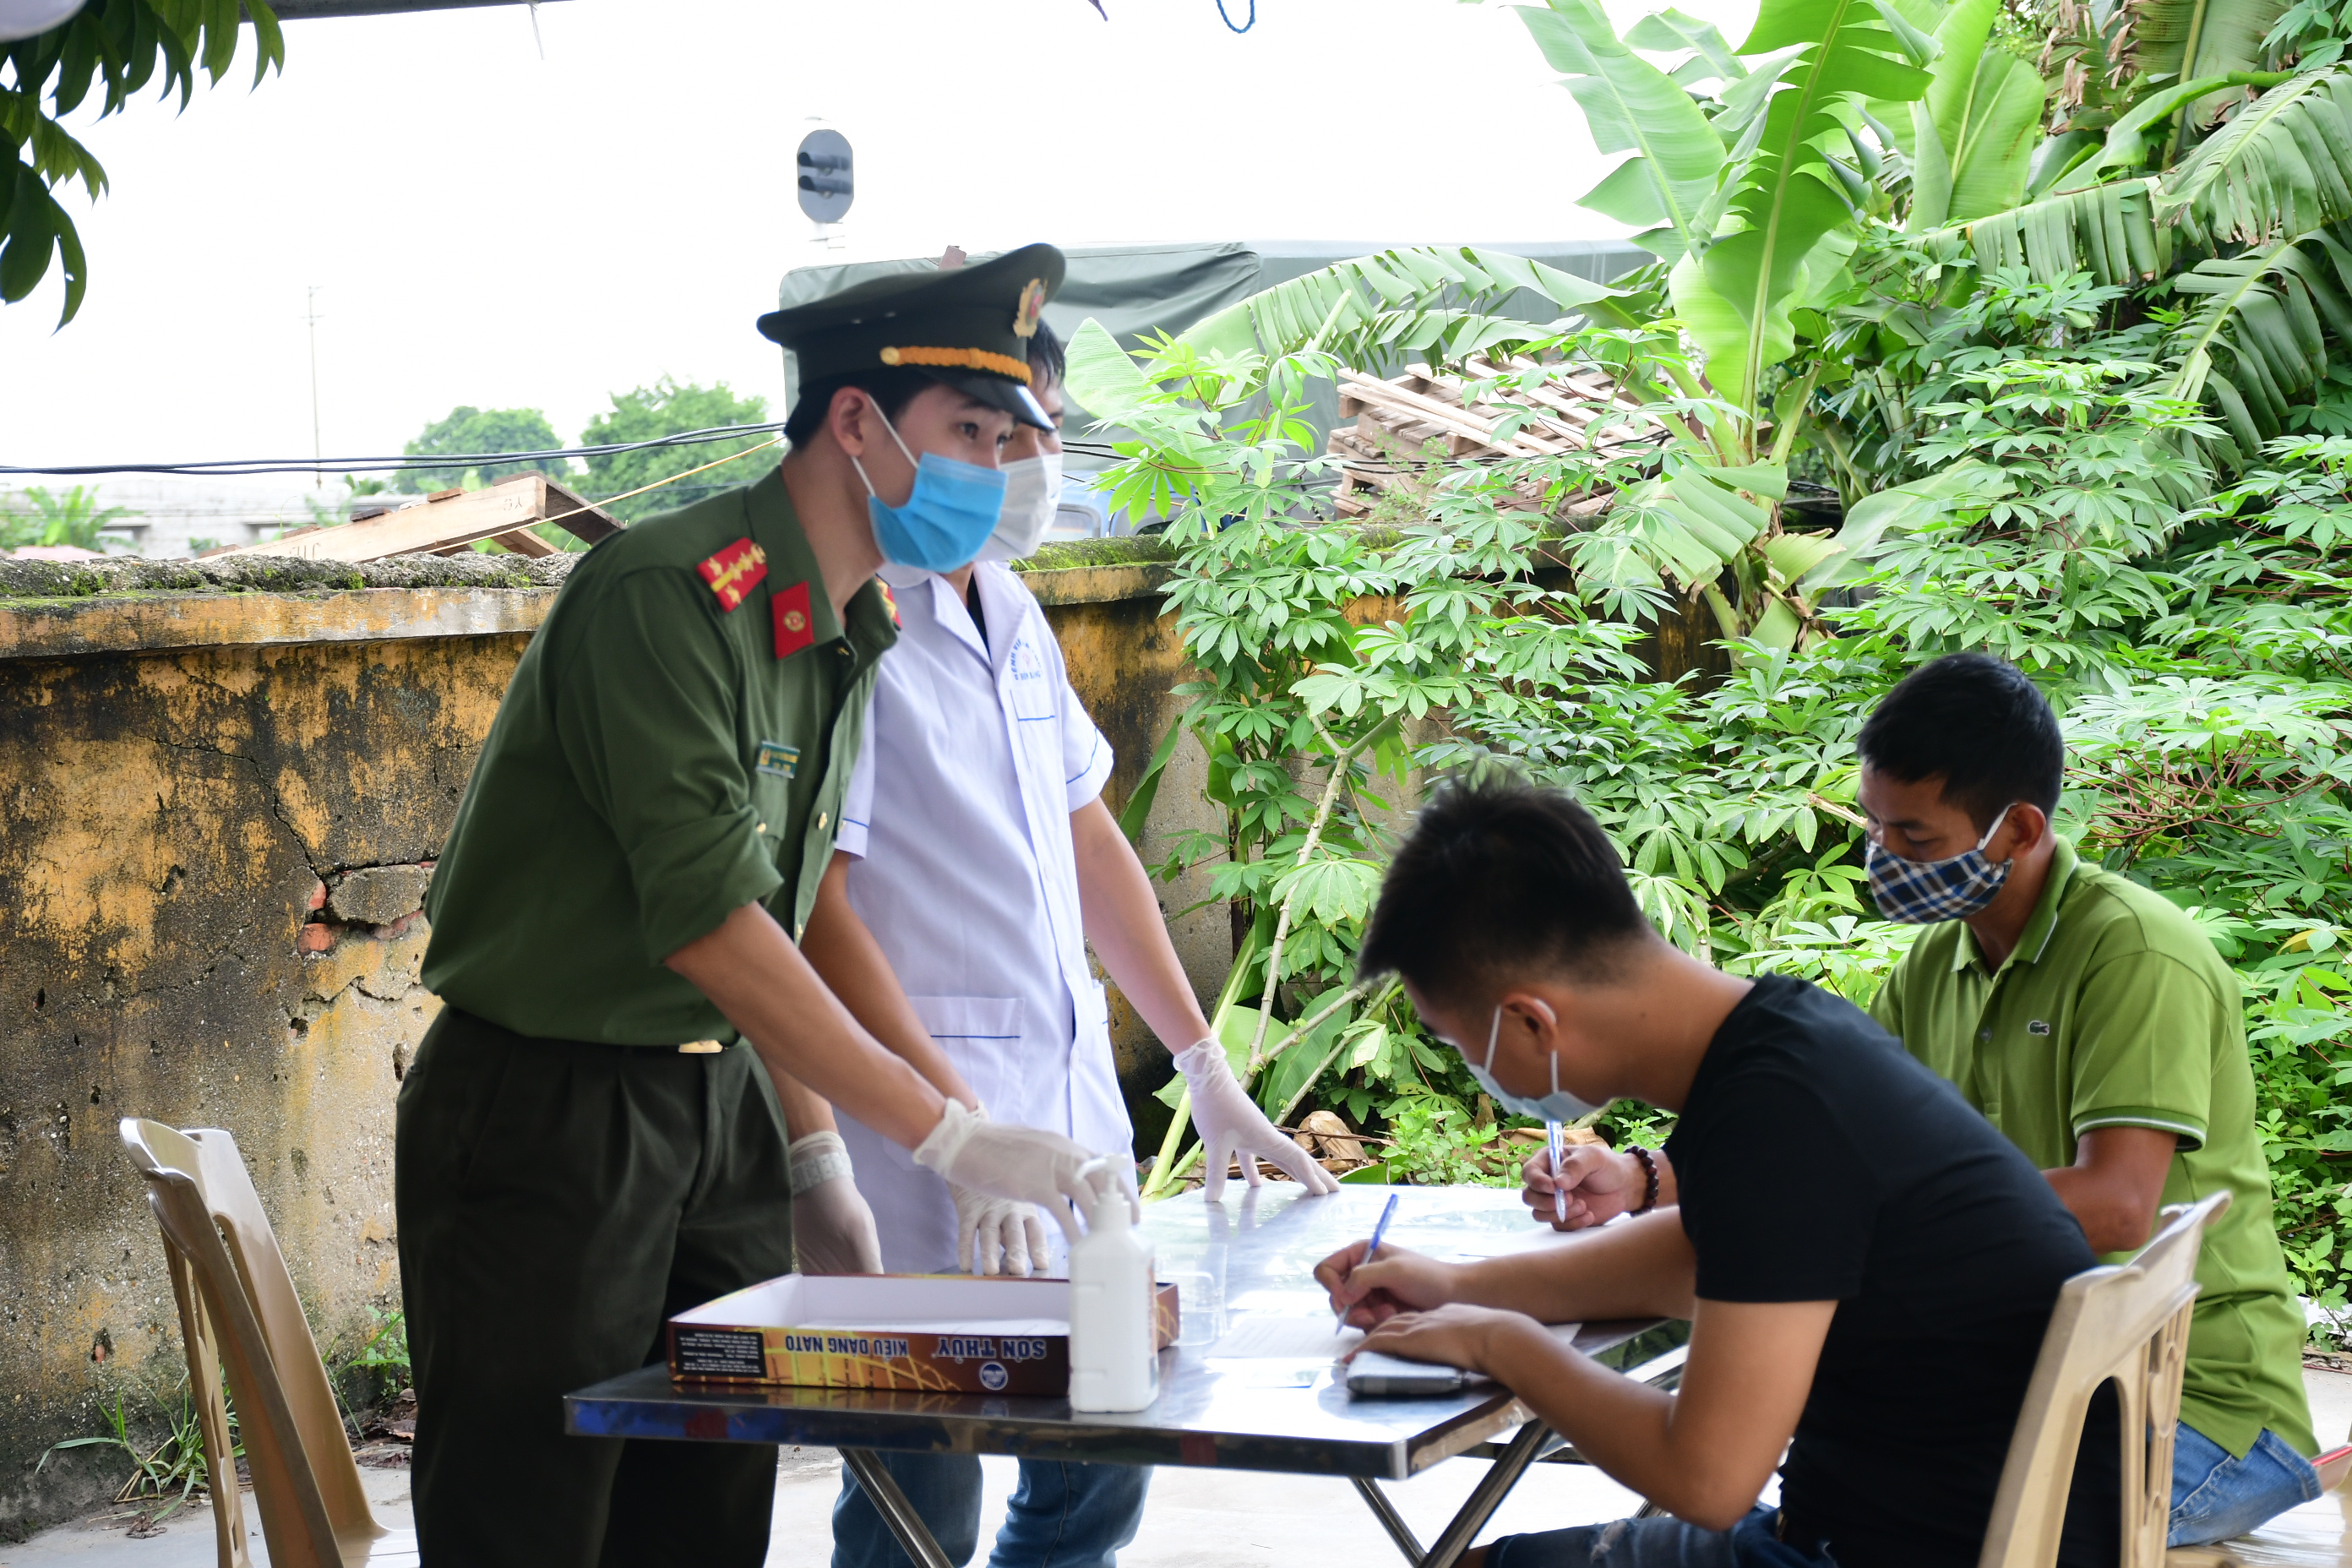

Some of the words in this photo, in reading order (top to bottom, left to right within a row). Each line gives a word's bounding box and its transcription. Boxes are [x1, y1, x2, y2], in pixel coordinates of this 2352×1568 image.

[785, 1335, 824, 1352] NATO
[938, 1337, 996, 1364] THỦY
[1002, 1338, 1047, 1363] SƠN
